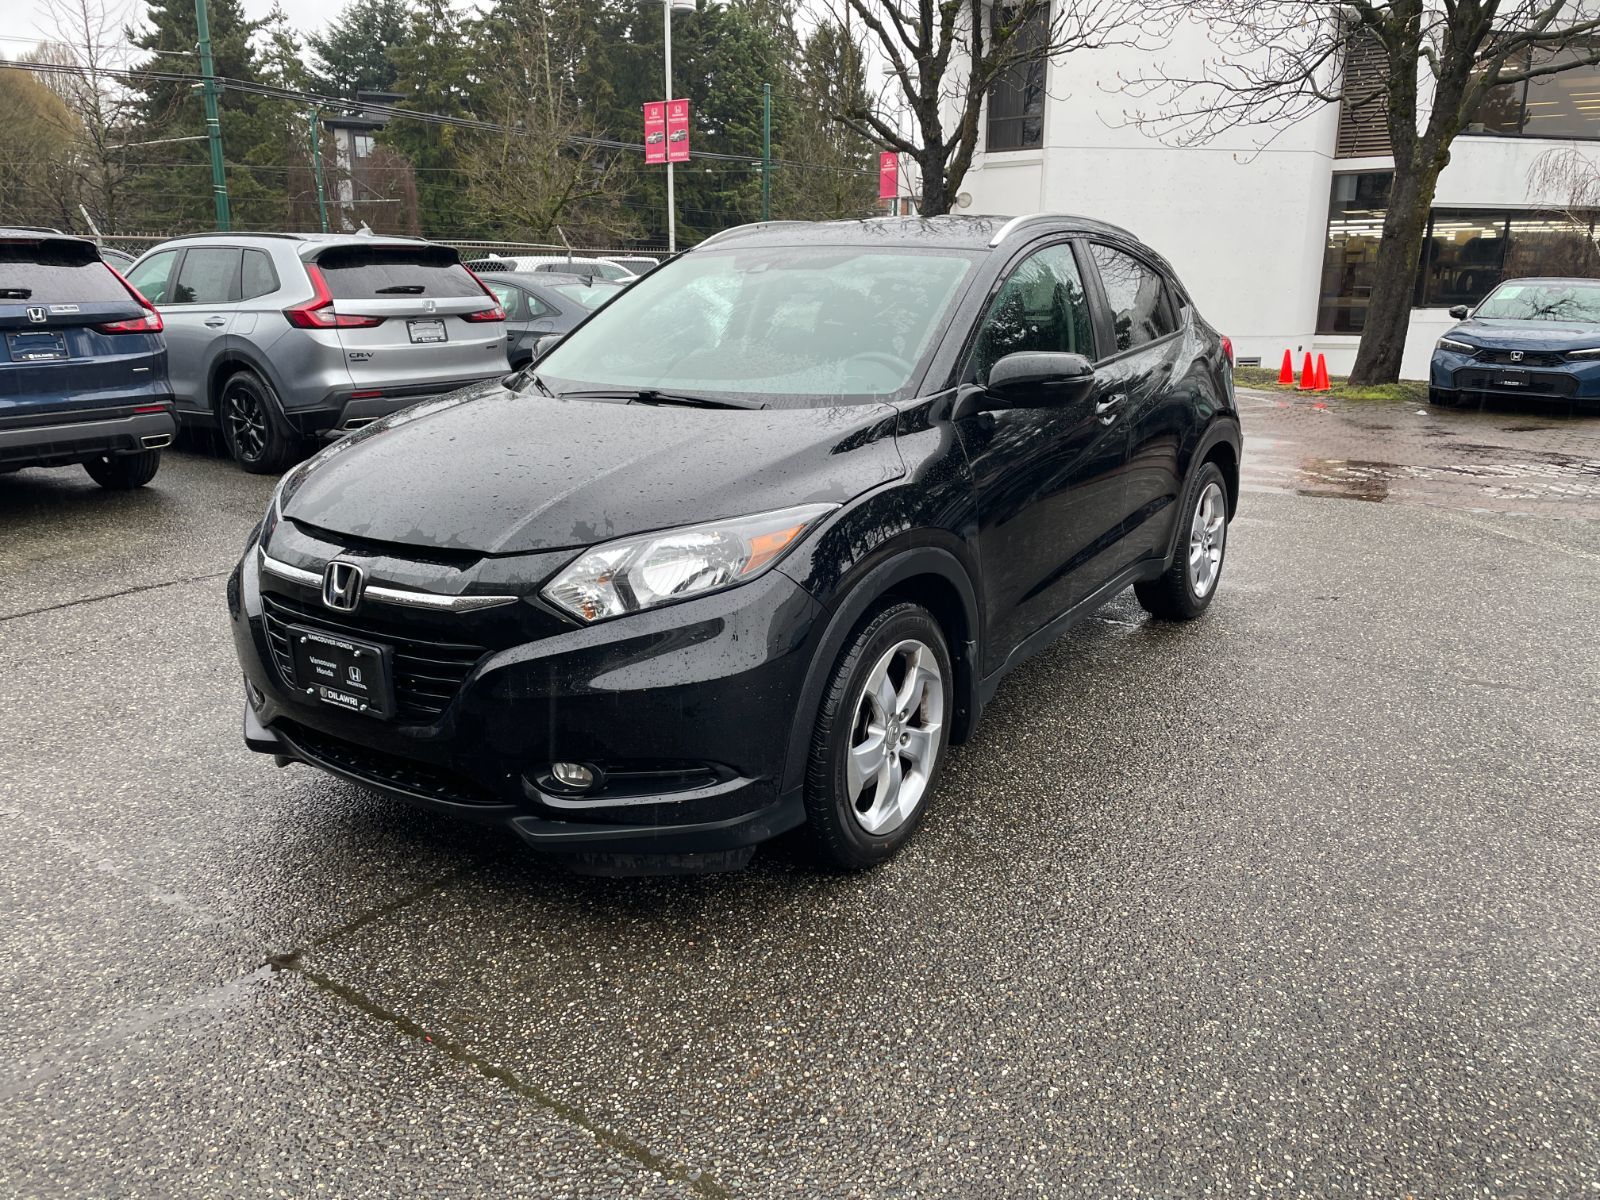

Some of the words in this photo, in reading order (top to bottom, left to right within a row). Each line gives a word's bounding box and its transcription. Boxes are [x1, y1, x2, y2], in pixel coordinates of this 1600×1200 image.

[308, 634, 335, 645] VANCOUVER
[336, 642, 353, 650] HONDA
[309, 656, 336, 669] Vancouver
[316, 667, 334, 677] Honda
[346, 680, 367, 690] HONDA
[328, 691, 358, 706] DILAWRI
